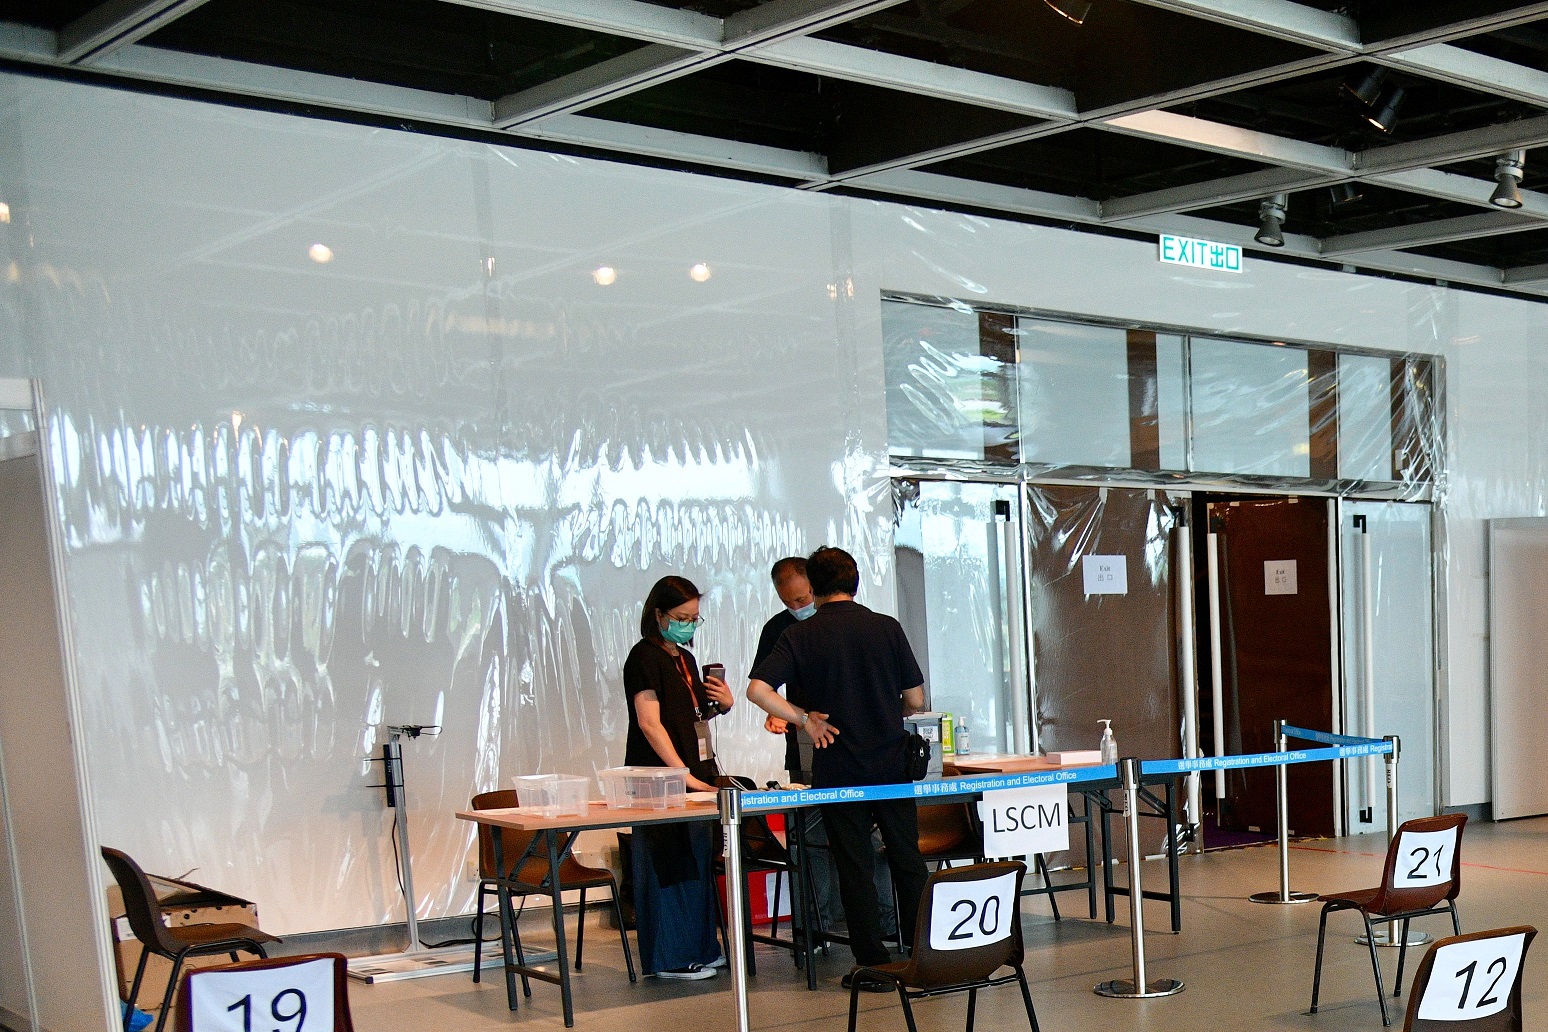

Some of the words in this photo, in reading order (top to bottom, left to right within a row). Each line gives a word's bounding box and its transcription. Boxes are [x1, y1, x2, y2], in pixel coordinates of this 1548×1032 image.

[1163, 236, 1208, 265] EXIT
[1210, 245, 1239, 270] 出口
[1214, 756, 1250, 768] Registration
[1250, 755, 1262, 764] and
[1263, 753, 1289, 763] Electoral
[1289, 751, 1307, 760] Office
[781, 793, 798, 803] and
[800, 789, 838, 802] Electoral
[839, 788, 865, 799] Office
[960, 779, 1005, 792] Registration
[1006, 776, 1021, 786] and
[1022, 773, 1054, 785] Electoral
[1055, 771, 1077, 781] Office
[992, 802, 1061, 833] LSCM
[1406, 844, 1445, 880] 21
[947, 895, 1000, 941] 20
[1454, 956, 1507, 1010] 12
